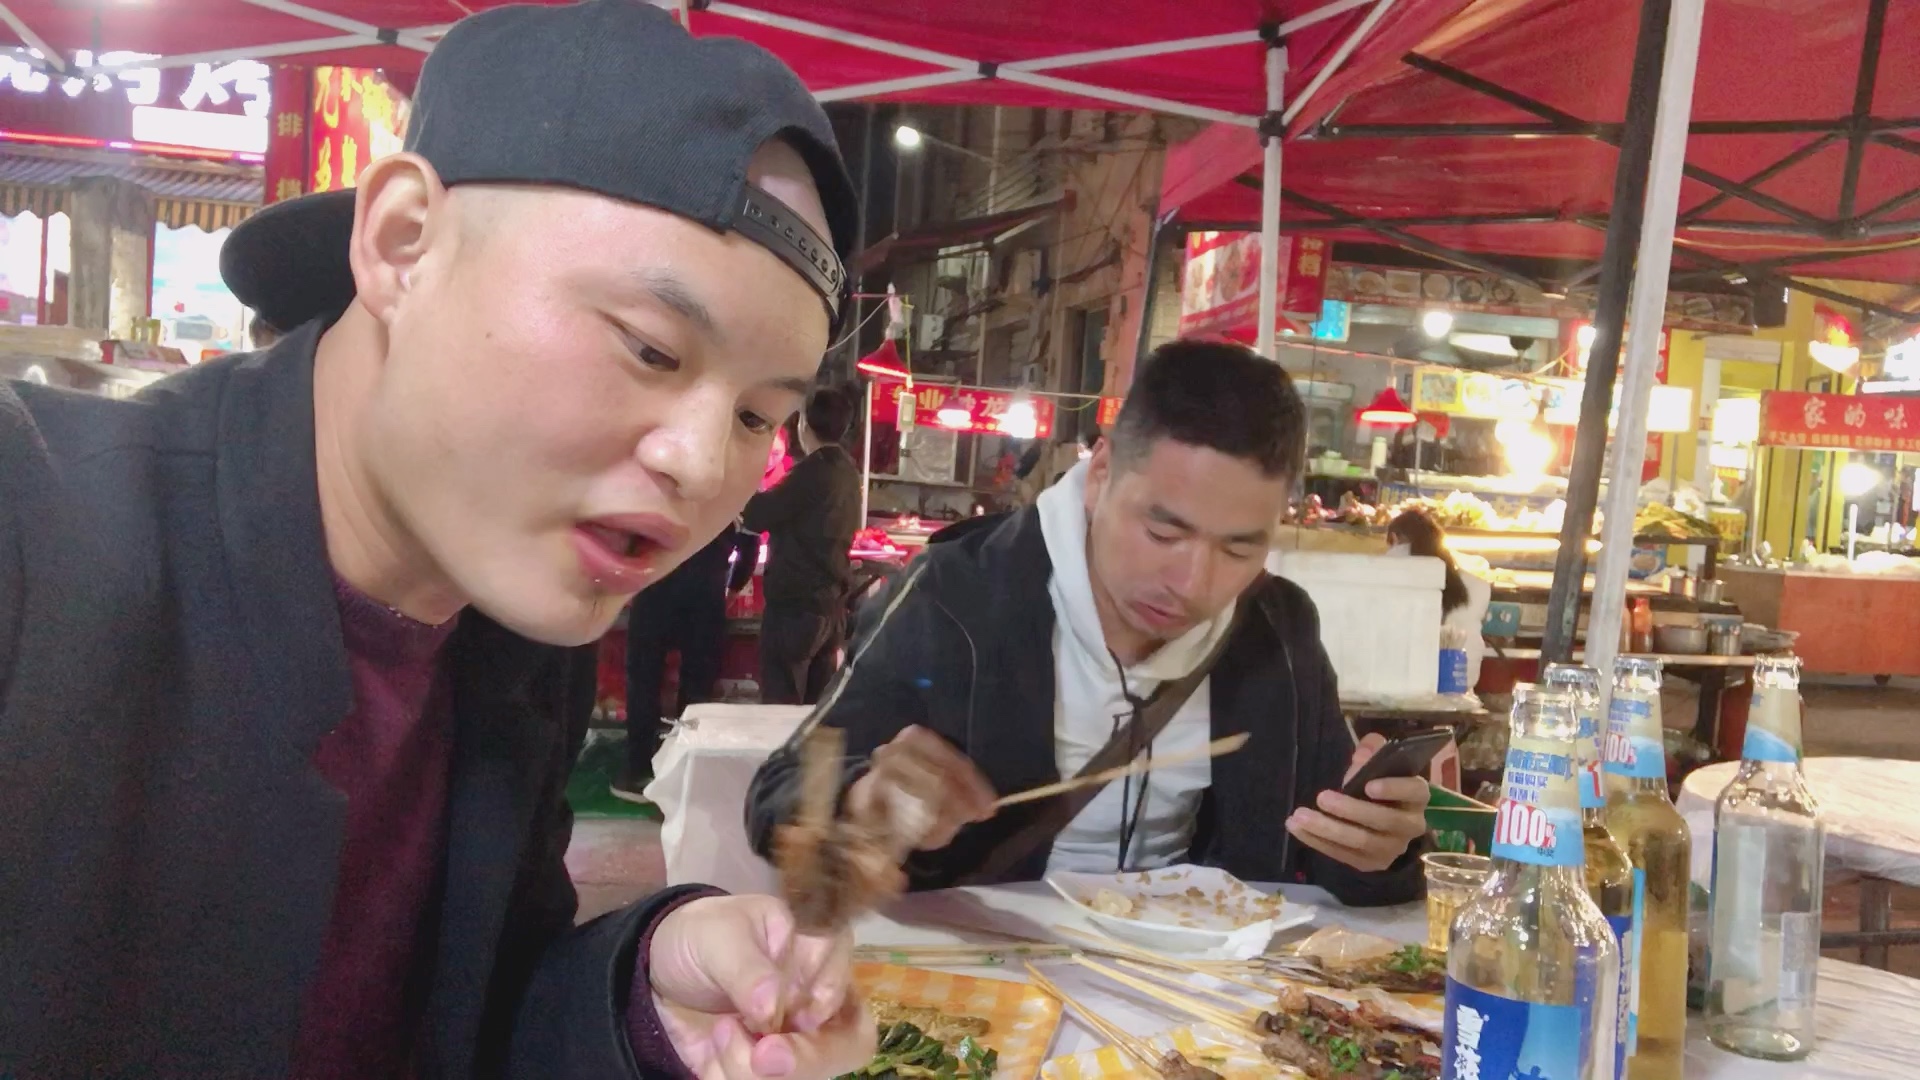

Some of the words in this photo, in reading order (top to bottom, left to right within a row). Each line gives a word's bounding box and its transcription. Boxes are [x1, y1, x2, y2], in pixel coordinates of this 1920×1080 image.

[1804, 396, 1908, 430] 家的味
[1497, 799, 1556, 848] 100%
